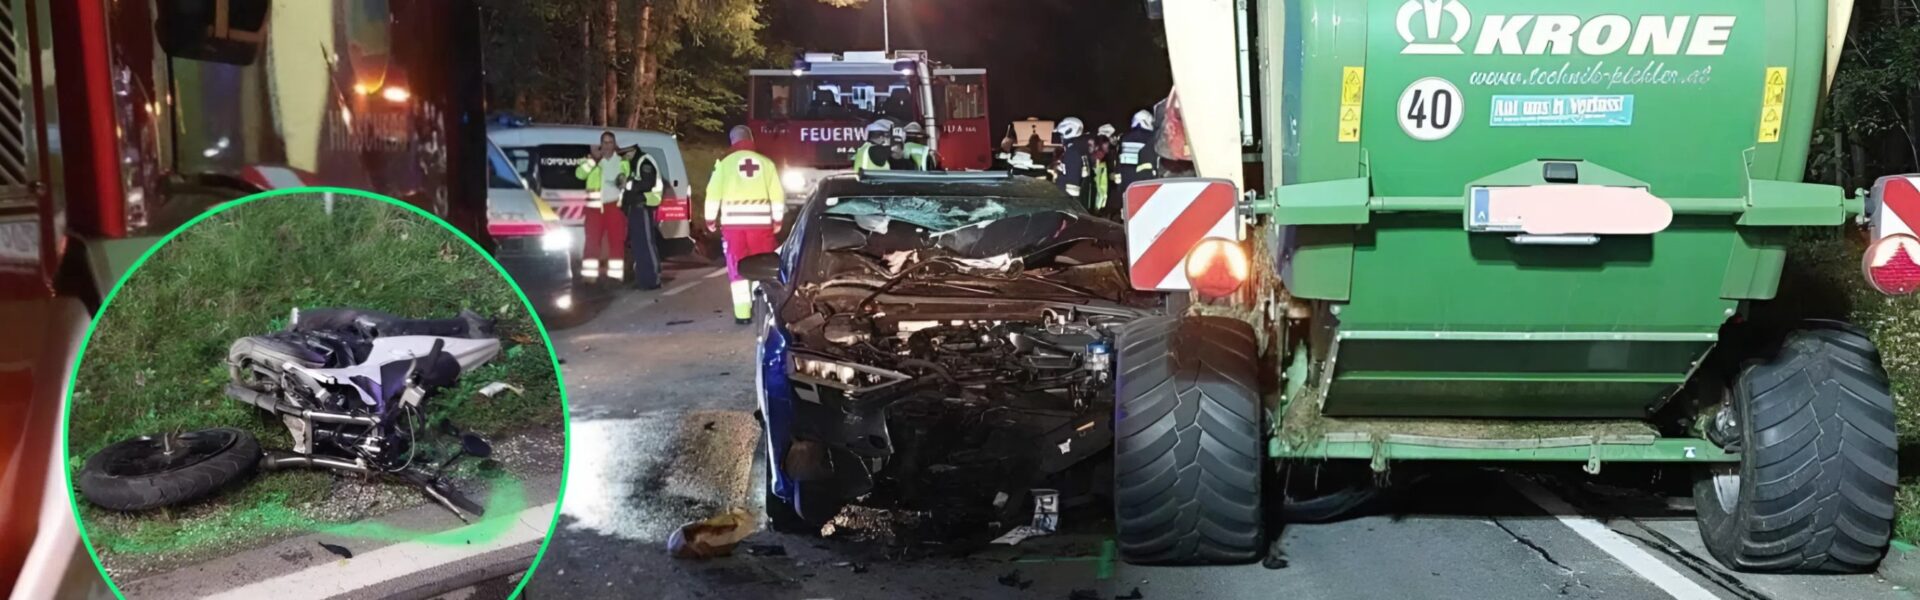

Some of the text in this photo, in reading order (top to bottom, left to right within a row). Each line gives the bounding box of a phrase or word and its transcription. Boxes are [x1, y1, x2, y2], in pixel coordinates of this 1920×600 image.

[1473, 14, 1737, 56] KRONE
[1407, 89, 1451, 129] 40
[800, 127, 870, 141] FEUERW
